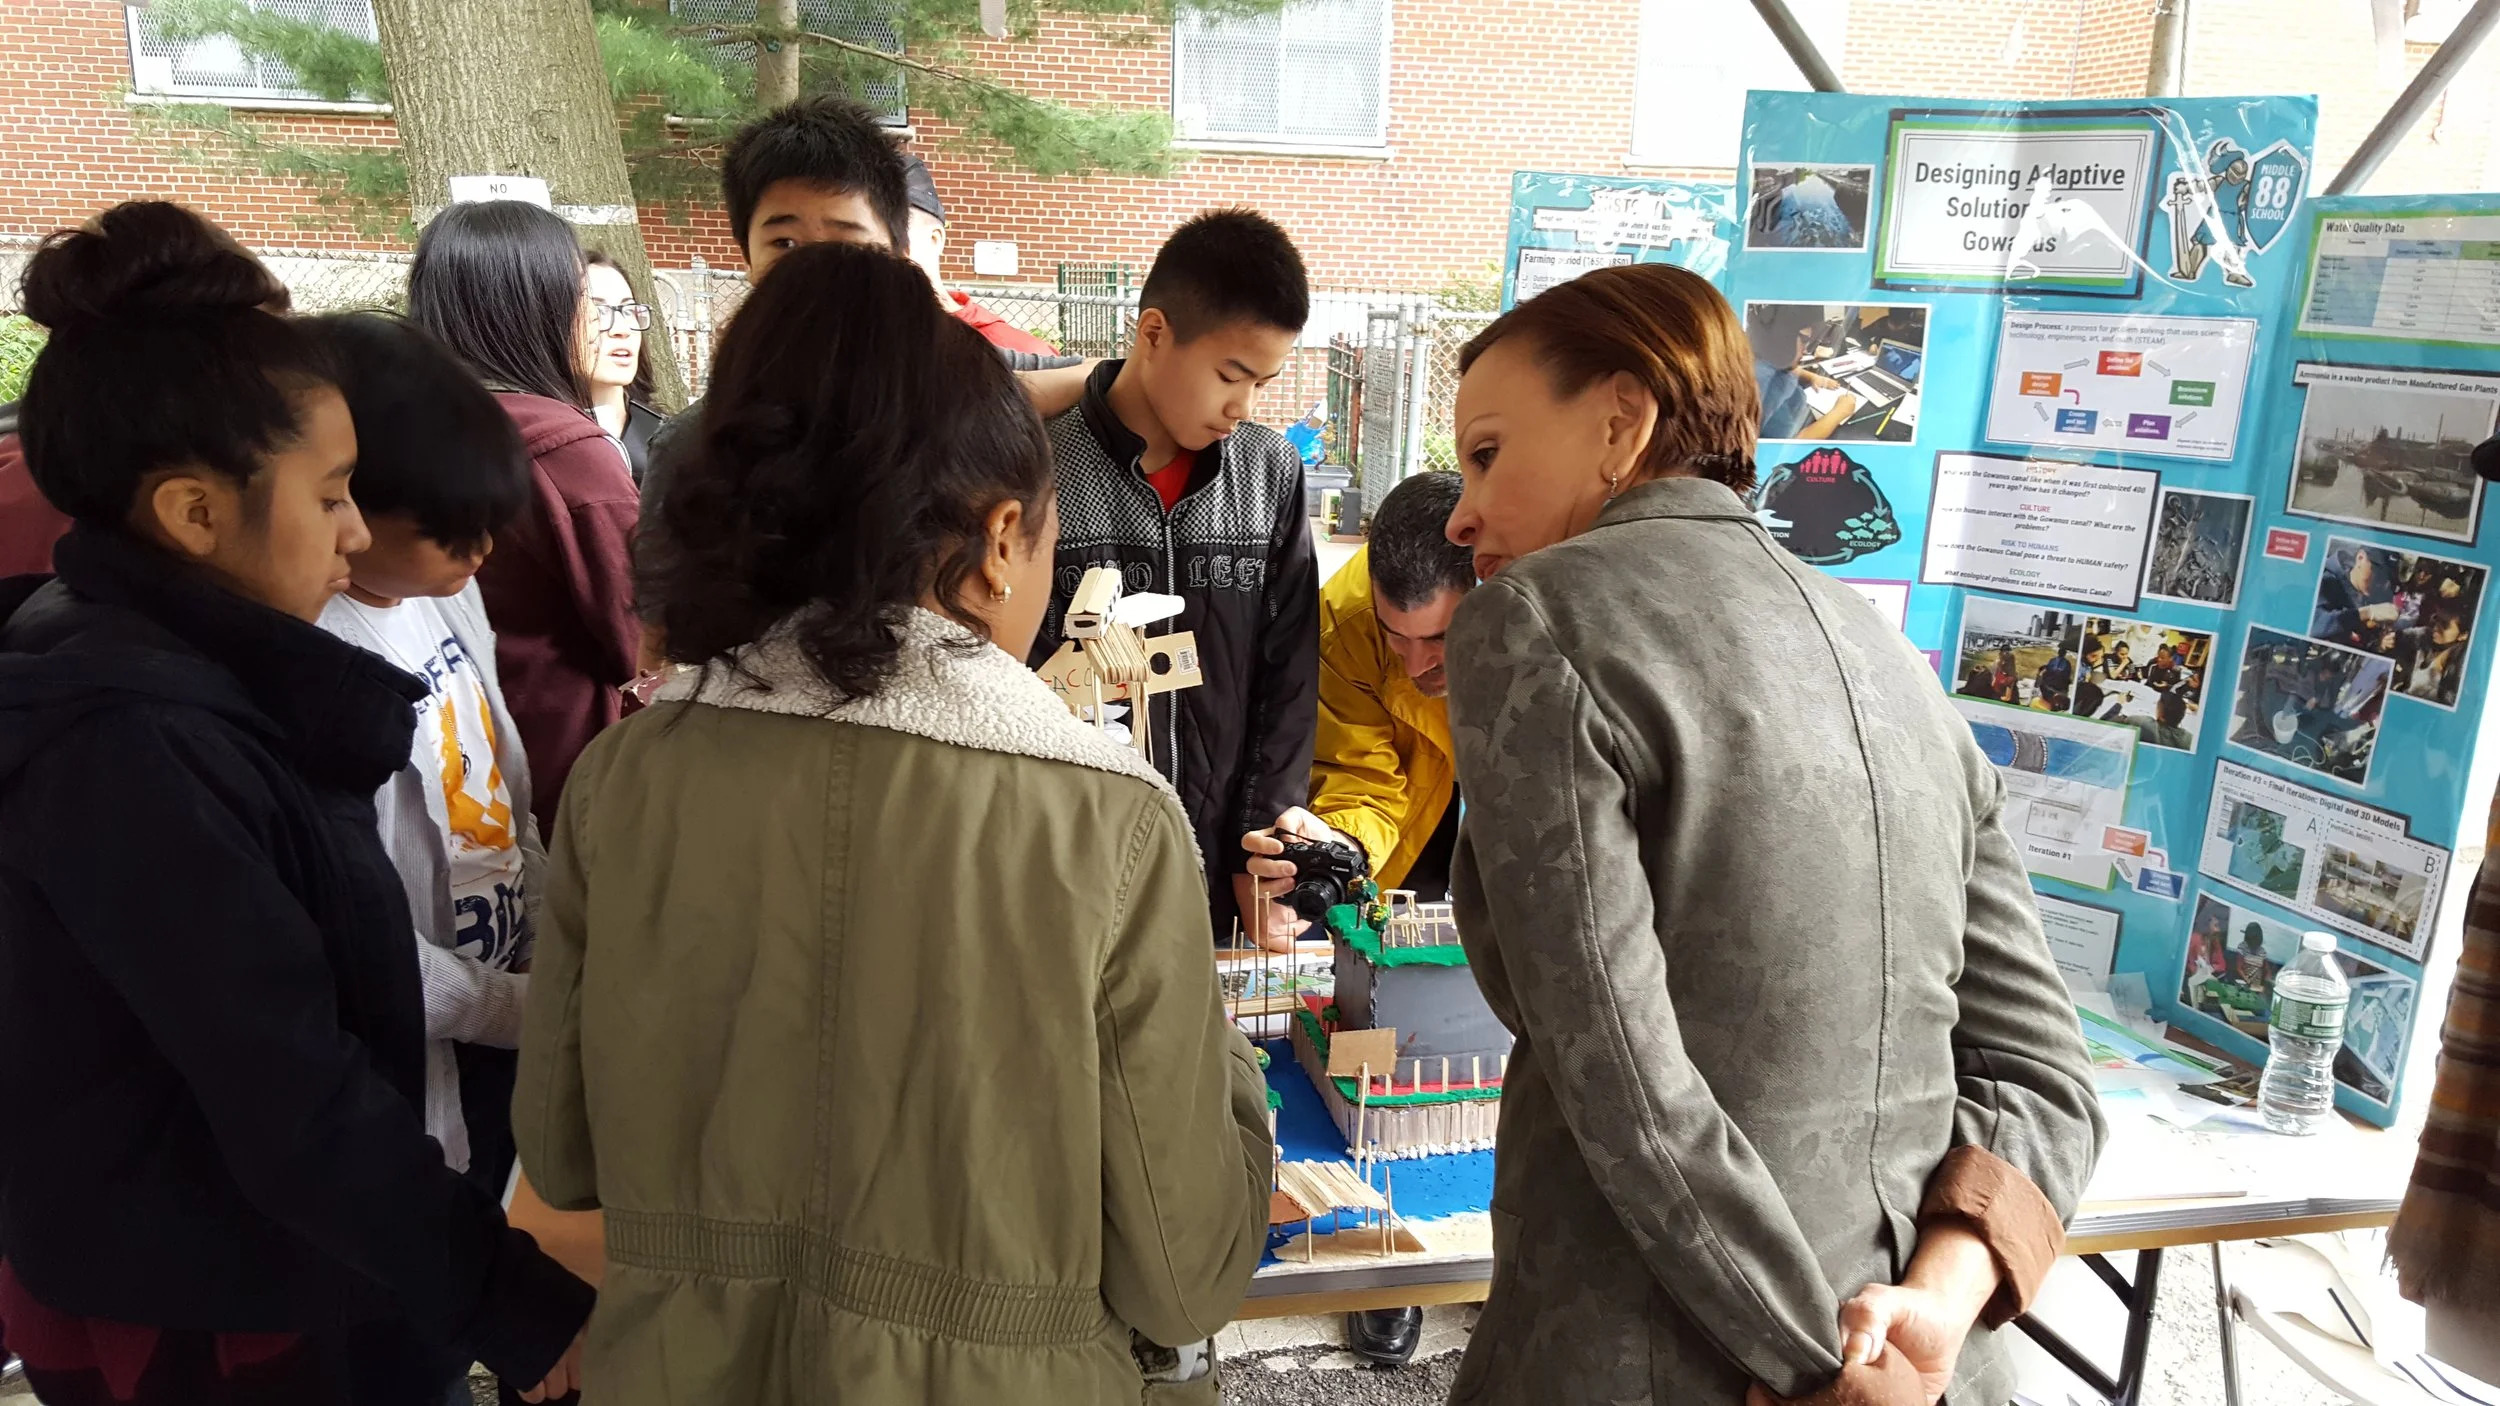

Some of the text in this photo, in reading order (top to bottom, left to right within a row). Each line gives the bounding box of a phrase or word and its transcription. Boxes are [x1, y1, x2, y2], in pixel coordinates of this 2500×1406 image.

[1915, 162, 2126, 190] Designing Adaptive
[2261, 164, 2296, 176] MIDDLE
[490, 183, 508, 194] NO
[2254, 175, 2291, 209] 88
[1946, 196, 2031, 219] Solutio
[2251, 207, 2285, 221] SCHOOL
[2353, 222, 2383, 236] Quality
[2384, 222, 2405, 233] Data
[1963, 230, 2057, 253] Gowaus
[1524, 253, 1556, 265] Farming
[2010, 321, 2033, 330] Design
[2344, 374, 2364, 382] waste
[2364, 375, 2391, 384] product
[2409, 379, 2458, 391] Manufactured
[2459, 382, 2473, 392] Gas
[2474, 384, 2499, 394] Plants
[1806, 476, 1836, 484] CULTURE
[1983, 471, 2010, 480] Gowanus
[2082, 480, 2098, 489] first
[2098, 482, 2132, 493] colonized
[1988, 482, 2006, 490] years
[2006, 484, 2022, 492] ago?
[2023, 485, 2038, 493] How
[2058, 488, 2091, 499] changed?
[2019, 503, 2051, 513] CULTURE
[1963, 506, 1987, 516] humans
[1987, 509, 2013, 518] interact
[2013, 511, 2027, 519] with
[2039, 514, 2069, 525] Gowanus
[2070, 518, 2093, 527] canal?
[2093, 520, 2111, 530] What
[2014, 521, 2050, 532] problems?
[1849, 540, 1882, 549] ECOLOGY
[2000, 538, 2017, 547] RISK
[2028, 542, 2060, 552] HUMANS
[1976, 545, 2004, 555] Gowanus
[2004, 548, 2023, 557] Canal
[2023, 551, 2040, 560] pose
[2046, 554, 2067, 563] threat
[2075, 557, 2103, 567] HUMAN
[2103, 560, 2129, 571] safety?
[2009, 567, 2041, 578] ECOLOGY
[1960, 570, 1991, 581] ecological
[1991, 575, 2020, 586] problems
[2020, 578, 2038, 587] exist
[2058, 583, 2088, 594] Gowanus
[2089, 587, 2113, 597] Canal?
[2223, 765, 2252, 781] Iteration
[2252, 775, 2263, 785] #3
[2267, 780, 2286, 793] Final
[2286, 786, 2318, 804] Iteration:
[2318, 797, 2345, 813] Digital
[2344, 807, 2360, 817] and
[2360, 811, 2372, 820] 3D
[2371, 814, 2402, 832] Models
[2306, 816, 2318, 835] A
[2028, 843, 2072, 860] Iteration #1
[2423, 855, 2436, 874] B
